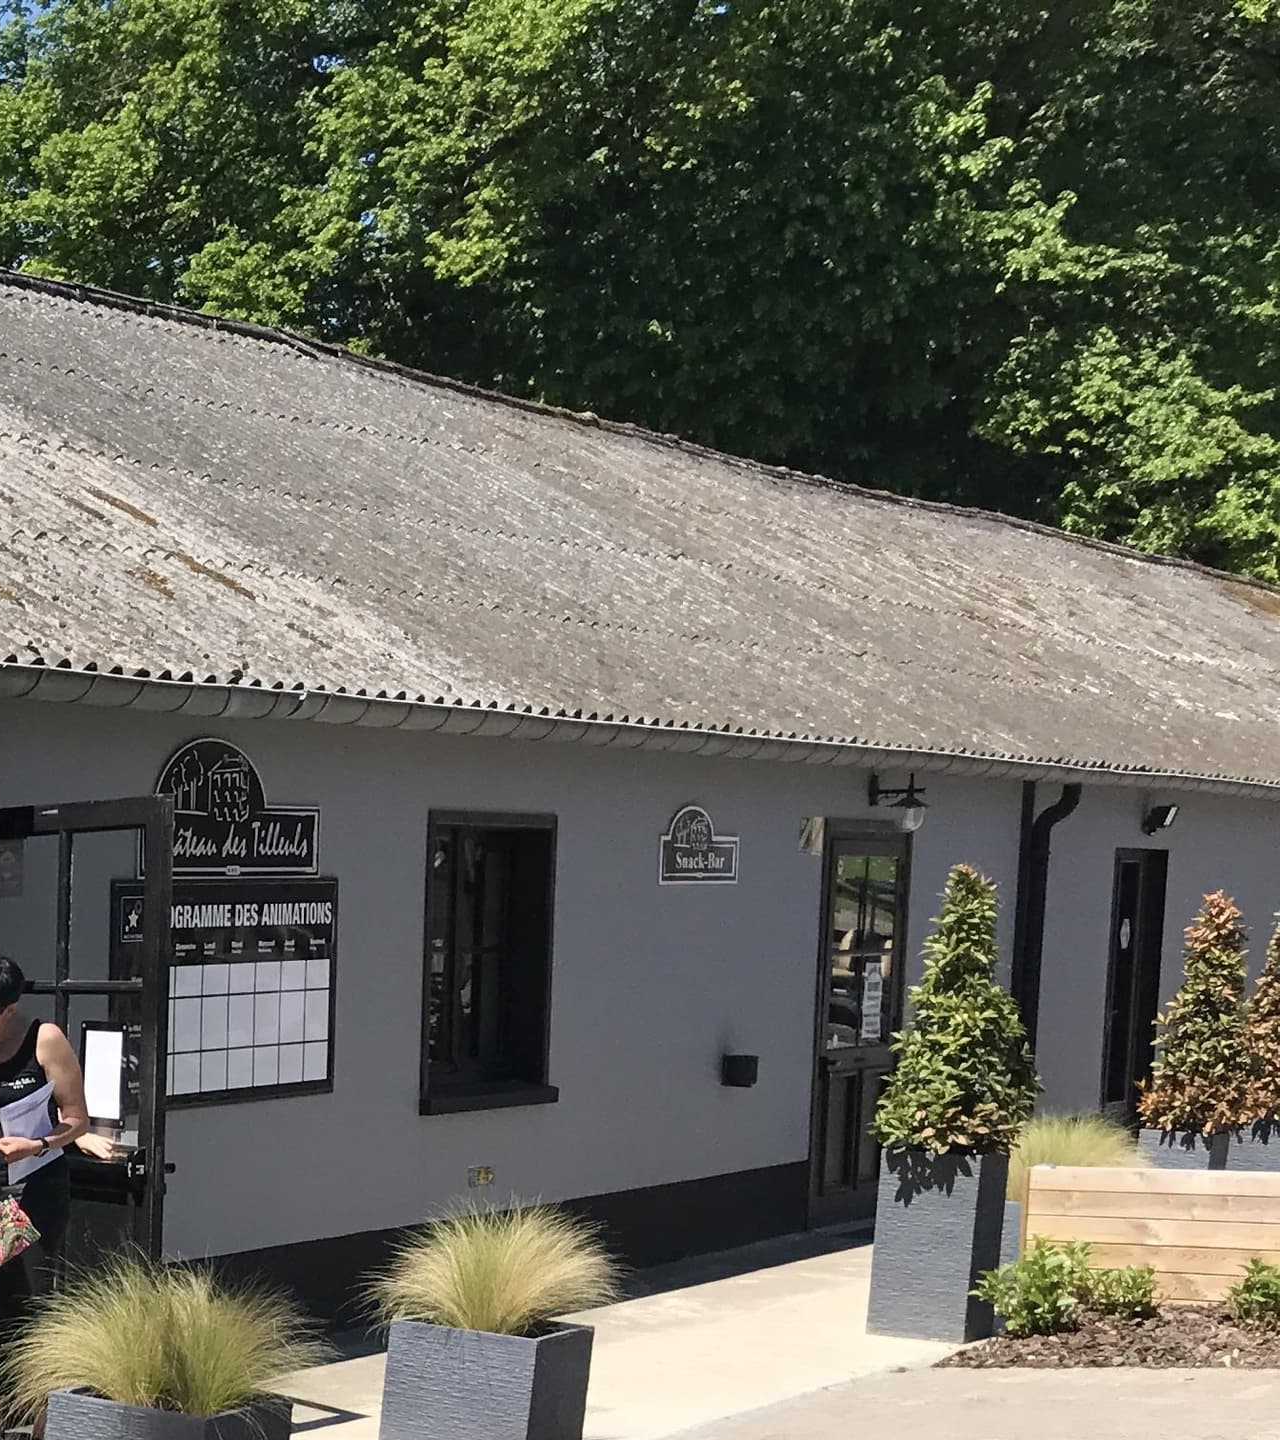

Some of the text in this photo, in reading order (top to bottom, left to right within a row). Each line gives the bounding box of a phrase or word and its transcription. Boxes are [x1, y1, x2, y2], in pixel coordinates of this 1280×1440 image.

[173, 822, 308, 858] âteau des Tilleuls
[675, 852, 726, 869] Snack-Bar
[170, 902, 333, 929] GRAMME DES ANIMATIONS
